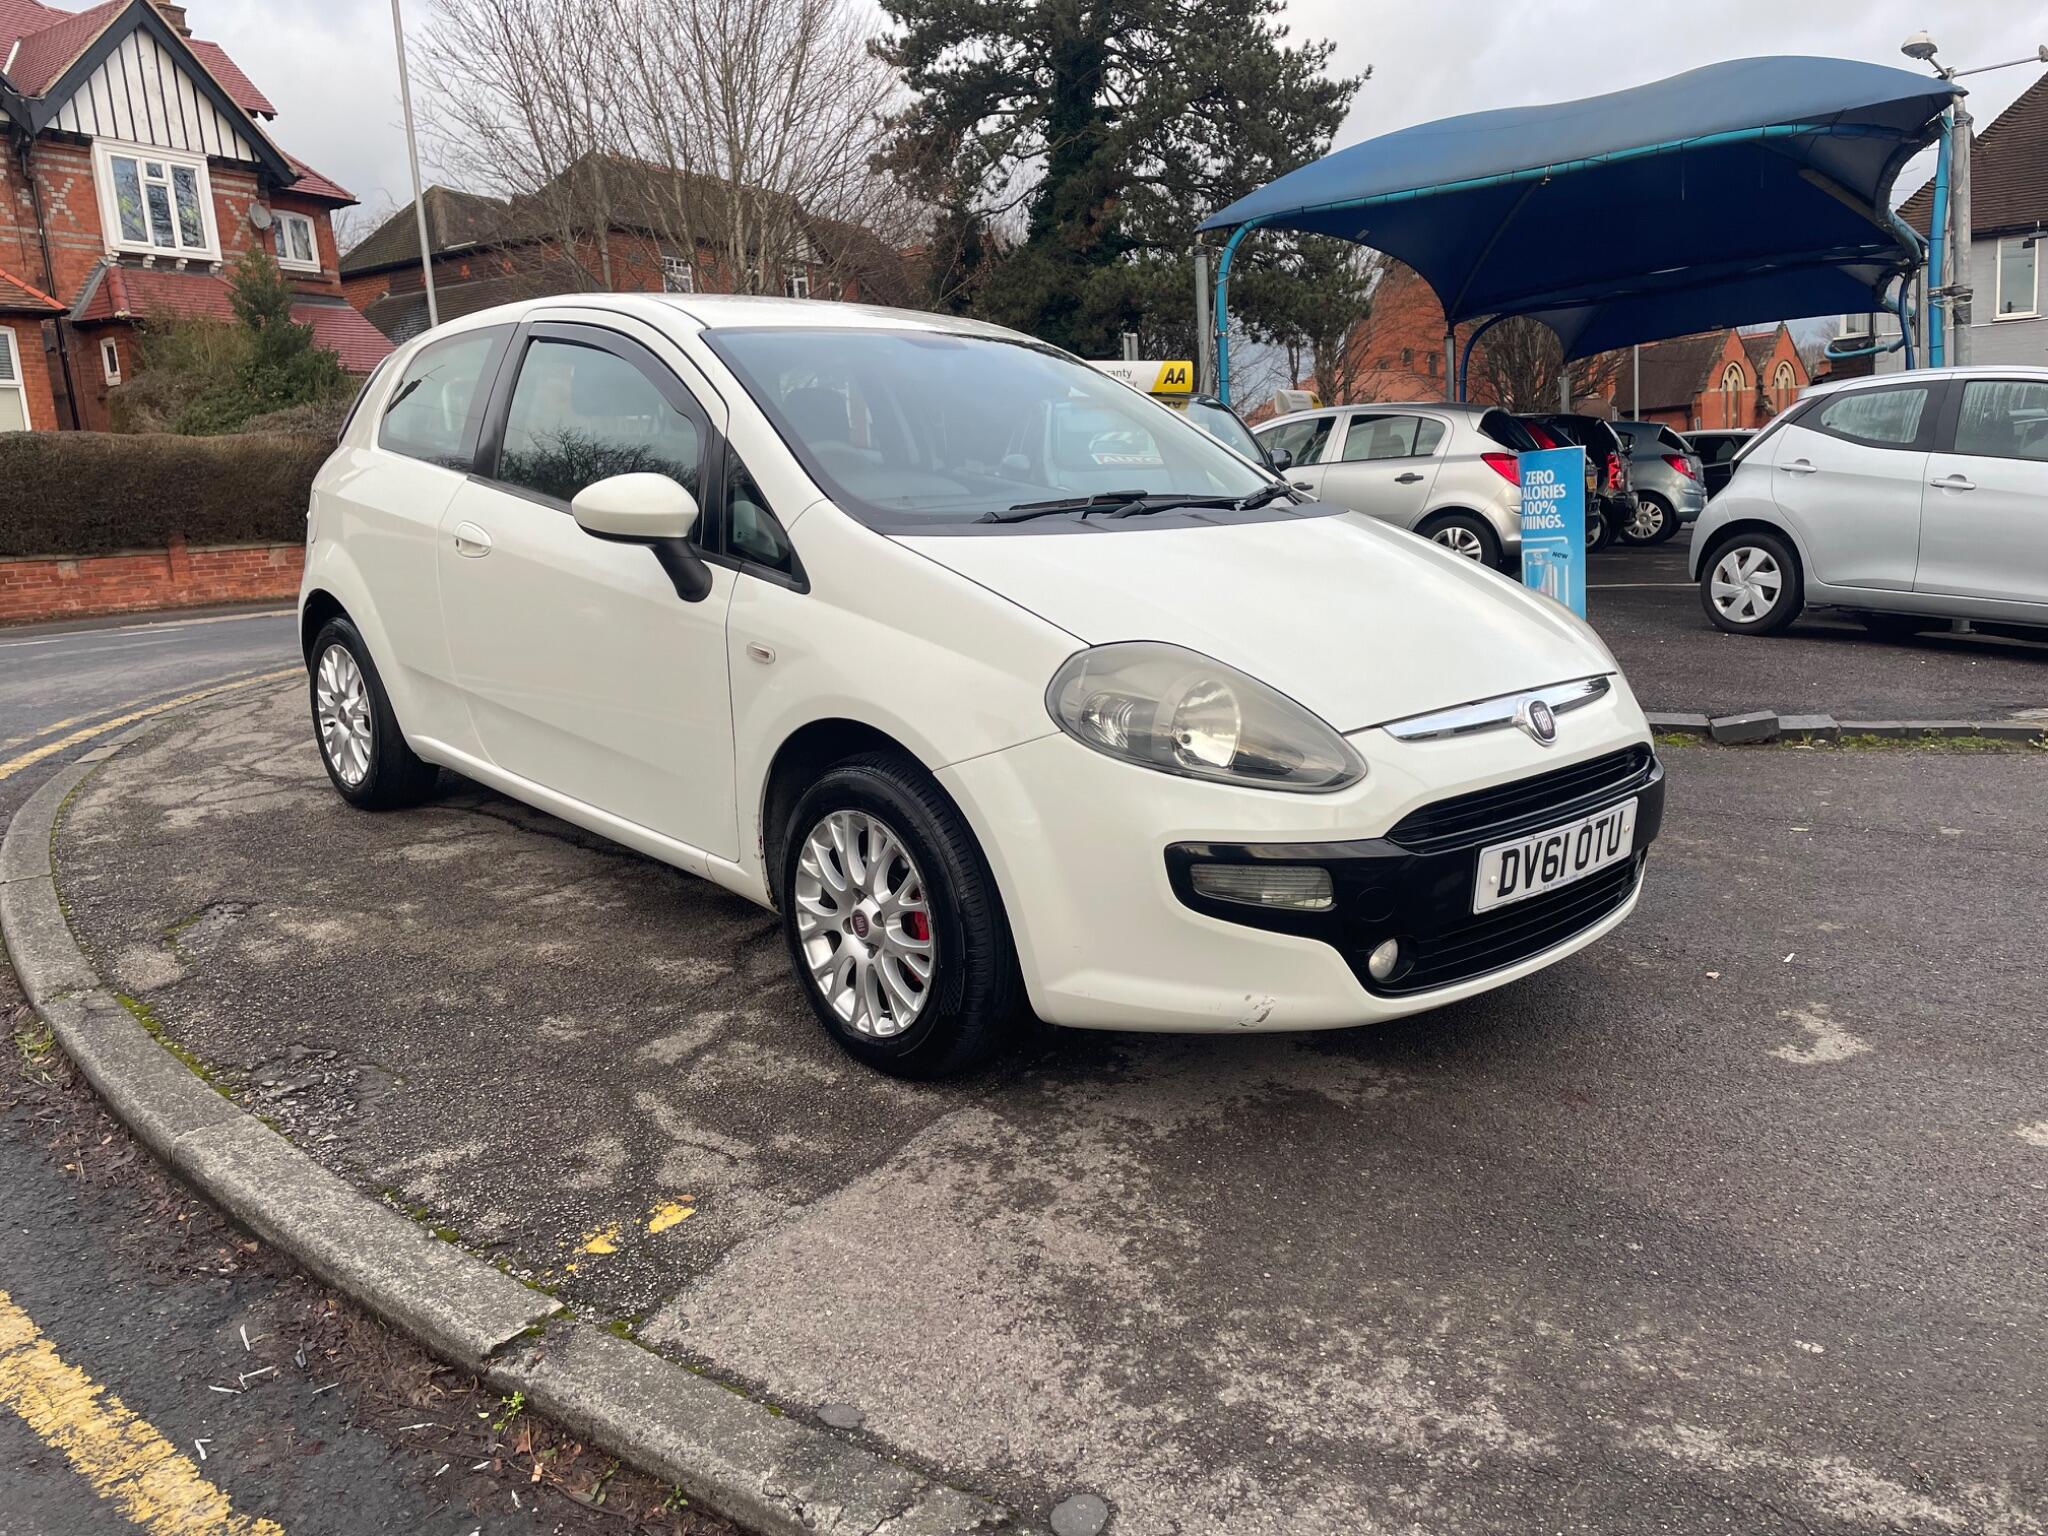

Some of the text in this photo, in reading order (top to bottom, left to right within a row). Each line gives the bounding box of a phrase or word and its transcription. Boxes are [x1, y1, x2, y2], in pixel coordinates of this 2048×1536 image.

[1163, 367, 1186, 385] AA
[1525, 470, 1554, 485] ZERO
[1521, 484, 1566, 500] ALORIES
[1524, 500, 1557, 515] 100%
[1497, 810, 1624, 898] DV61 OTU
